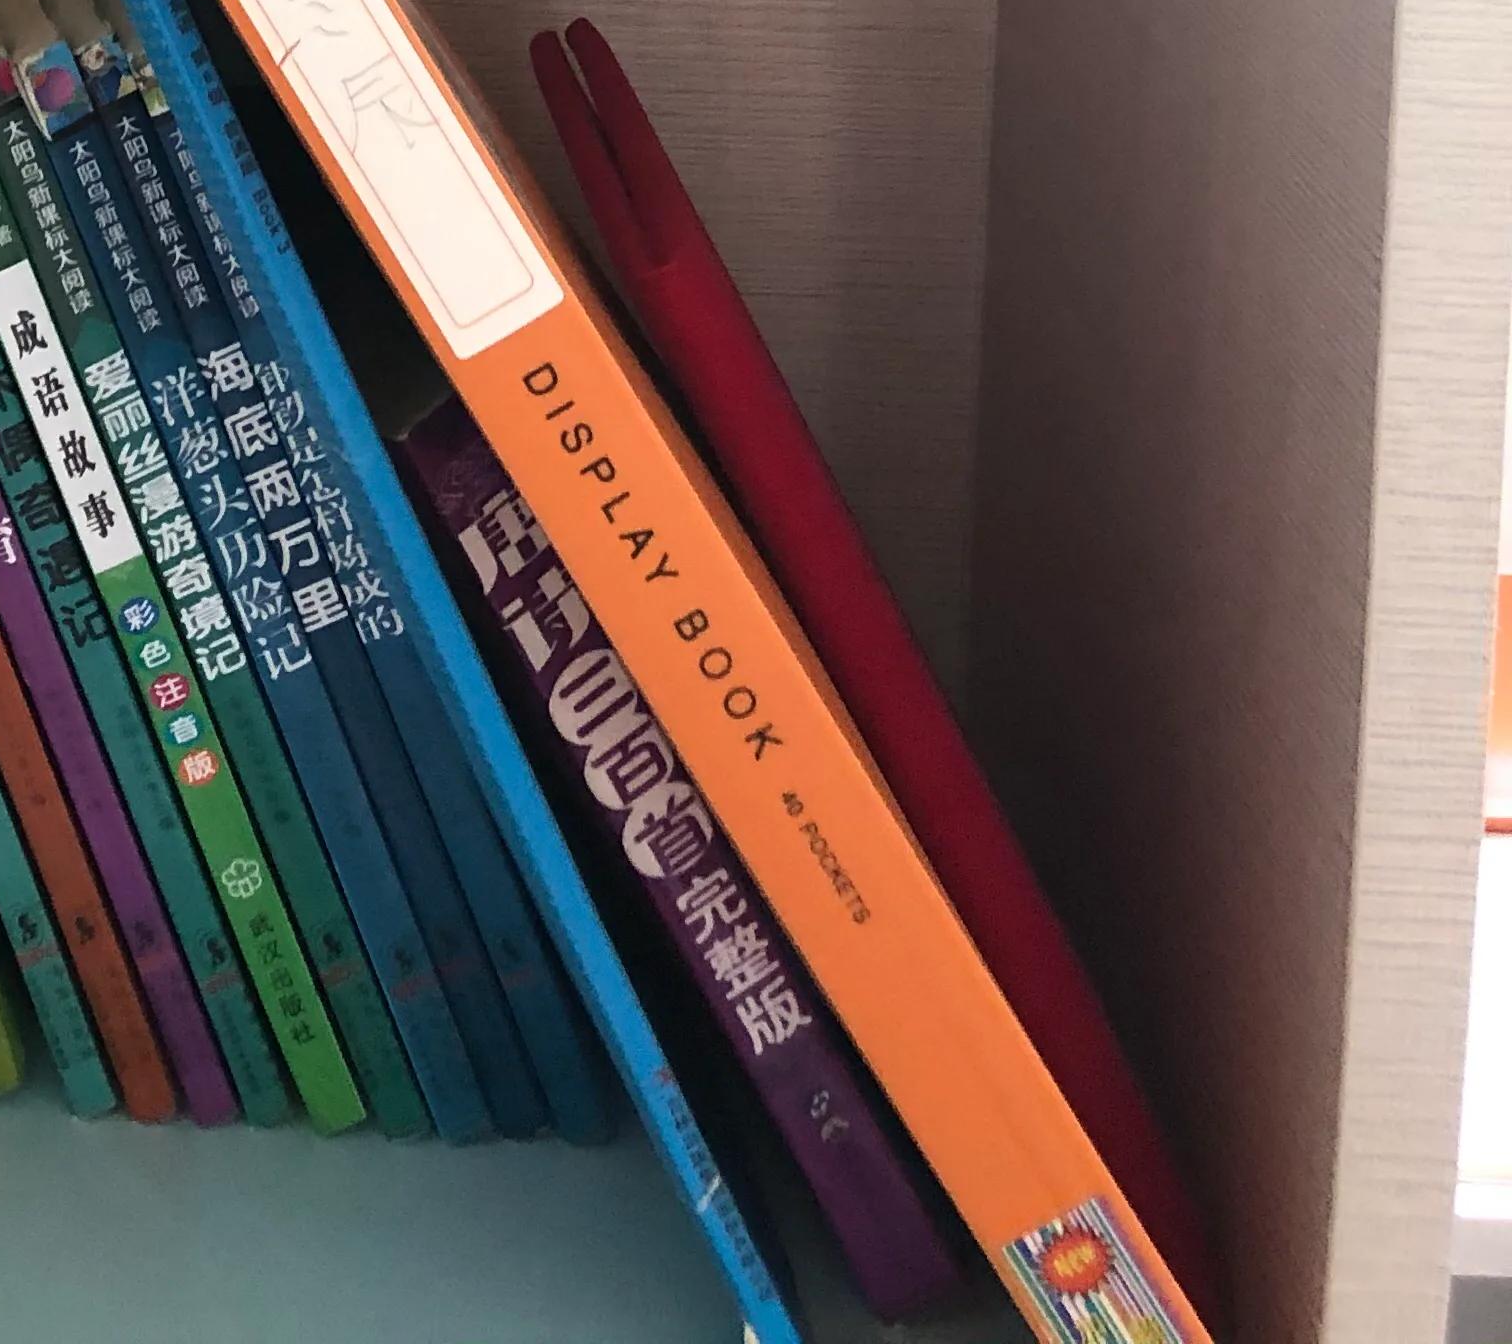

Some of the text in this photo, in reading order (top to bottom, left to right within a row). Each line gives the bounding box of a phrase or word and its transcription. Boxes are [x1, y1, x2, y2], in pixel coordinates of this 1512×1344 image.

[3, 119, 248, 681] 太阳鸟新课标大阅读 爱丽丝漫游奇境记
[10, 309, 118, 540] 成语故事
[67, 139, 314, 681] 太阳鸟新课标大阅读 洋葱头历险记
[117, 116, 209, 311] 太阳鸟新课标大阅读
[196, 341, 352, 633] 海底两万里
[121, 598, 219, 785] 彩色注音版
[522, 360, 872, 927] DISPLAY BOOK 40 POCKETS
